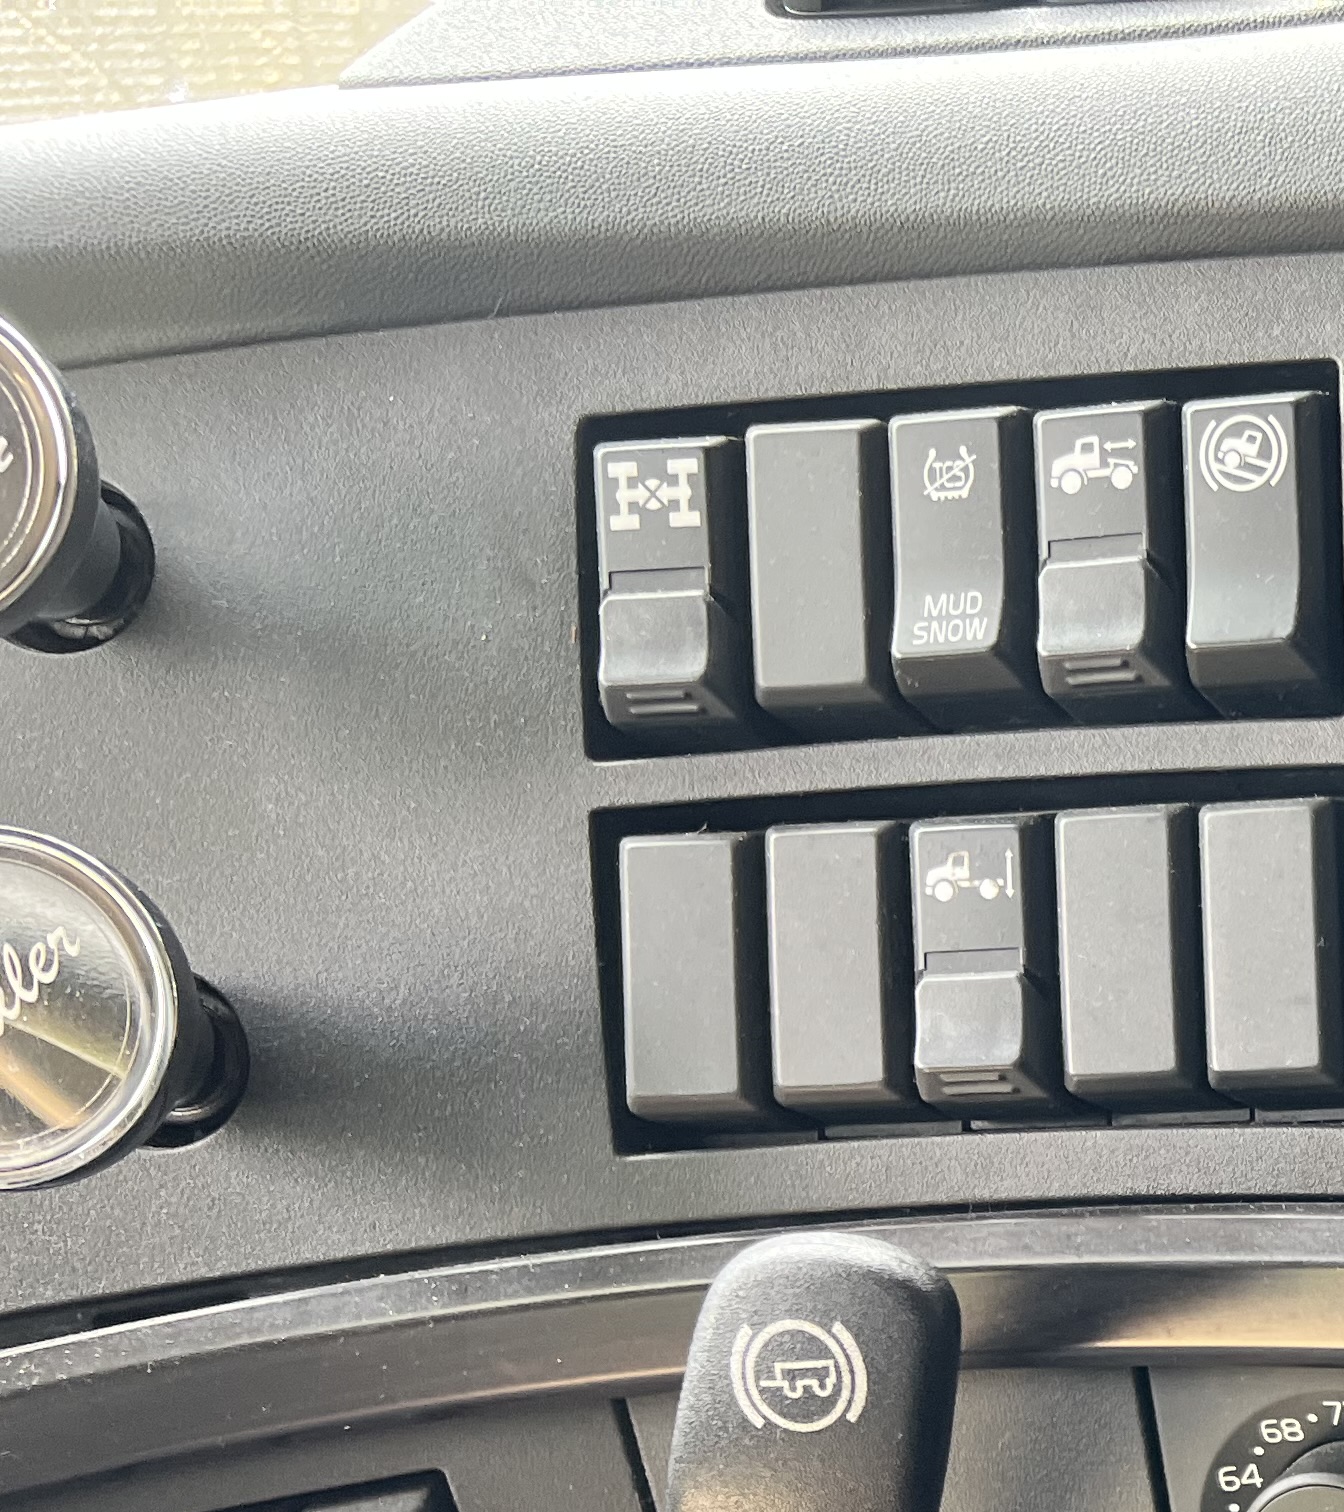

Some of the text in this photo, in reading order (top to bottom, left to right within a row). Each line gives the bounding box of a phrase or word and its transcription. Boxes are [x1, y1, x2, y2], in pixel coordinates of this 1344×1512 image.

[924, 591, 984, 618] MUD
[913, 617, 988, 645] SNOW
[1260, 1418, 1304, 1443] 68
[1218, 1463, 1263, 1491] 64
